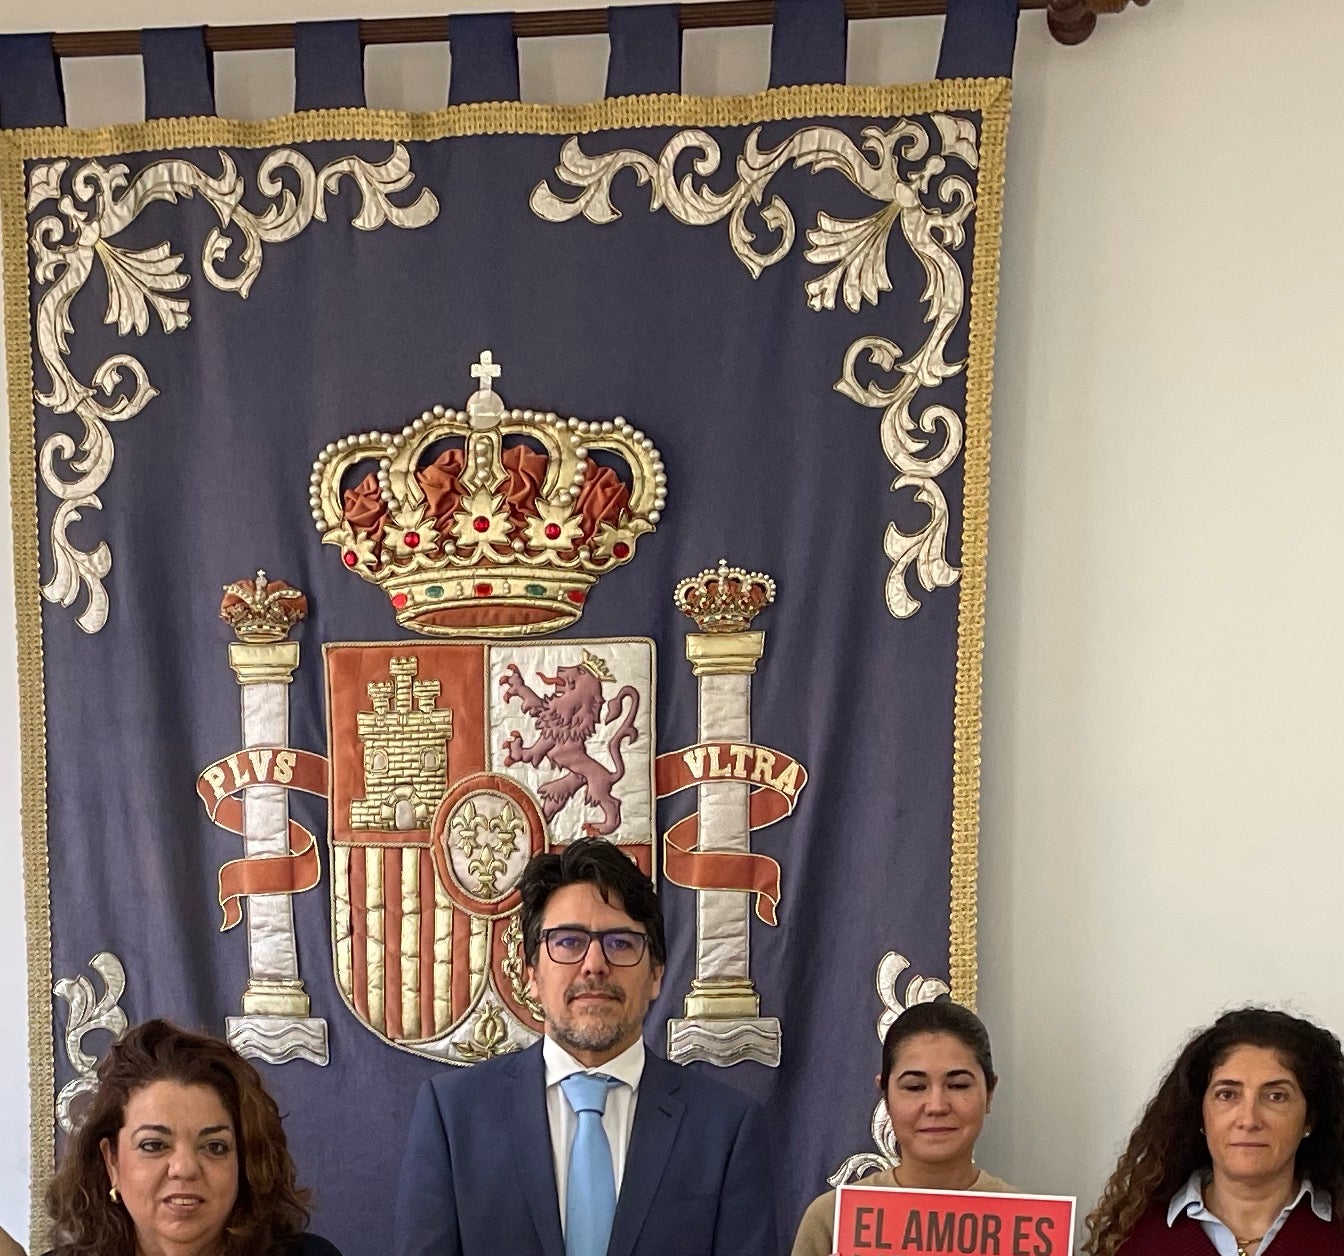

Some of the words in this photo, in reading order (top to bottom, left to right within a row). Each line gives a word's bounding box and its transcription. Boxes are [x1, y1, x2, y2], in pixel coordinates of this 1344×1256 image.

[202, 750, 297, 800] PLVS
[683, 745, 800, 795] VLTRA
[853, 1208, 892, 1250] EL
[902, 1210, 1002, 1256] AMOR
